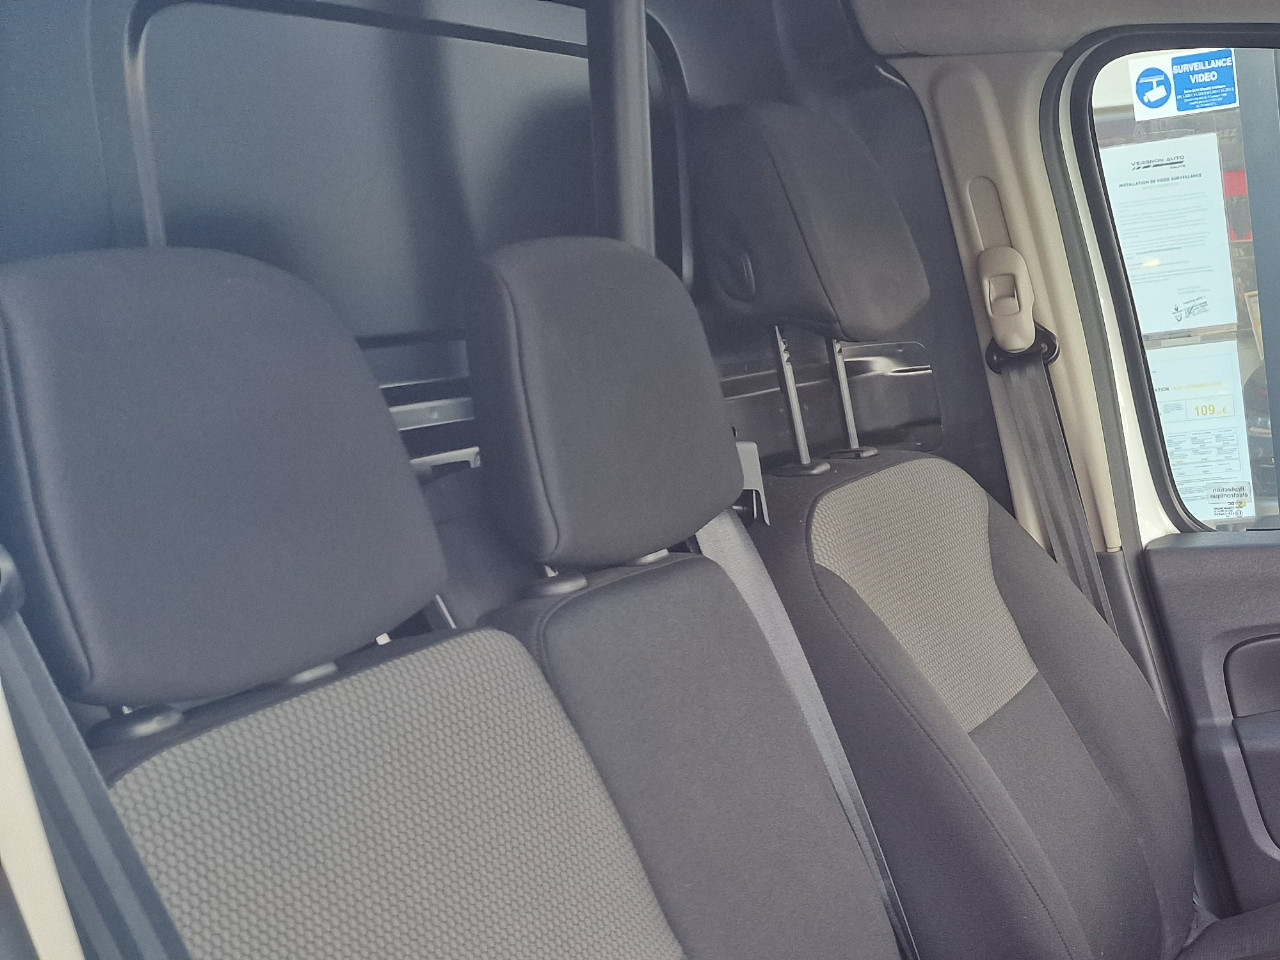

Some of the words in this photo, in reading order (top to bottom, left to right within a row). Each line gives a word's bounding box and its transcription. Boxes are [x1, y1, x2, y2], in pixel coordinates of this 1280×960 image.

[1172, 56, 1233, 74] SURVEILLANCE
[1189, 71, 1218, 84] VIDEO
[1194, 404, 1216, 416] 109
